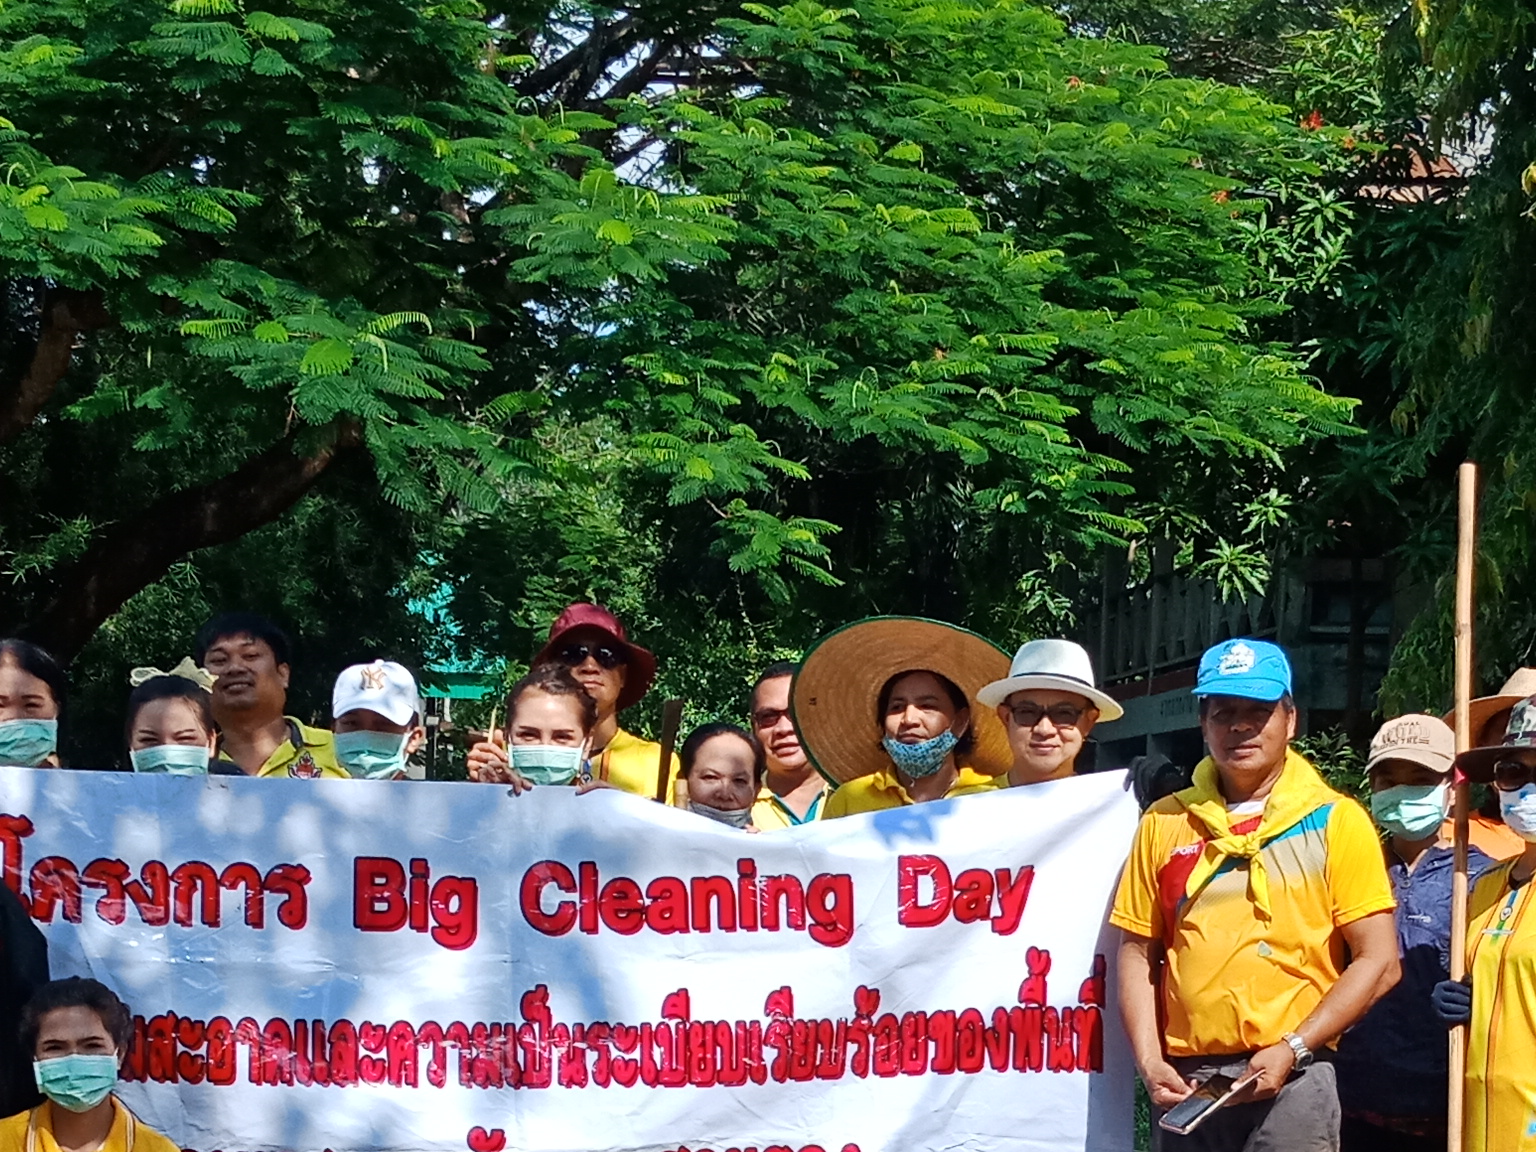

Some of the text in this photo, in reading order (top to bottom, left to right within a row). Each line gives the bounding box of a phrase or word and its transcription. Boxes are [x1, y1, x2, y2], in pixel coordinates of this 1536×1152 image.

[353, 856, 478, 950] Big
[520, 858, 853, 947] Cleaning
[897, 854, 1035, 936] Day
